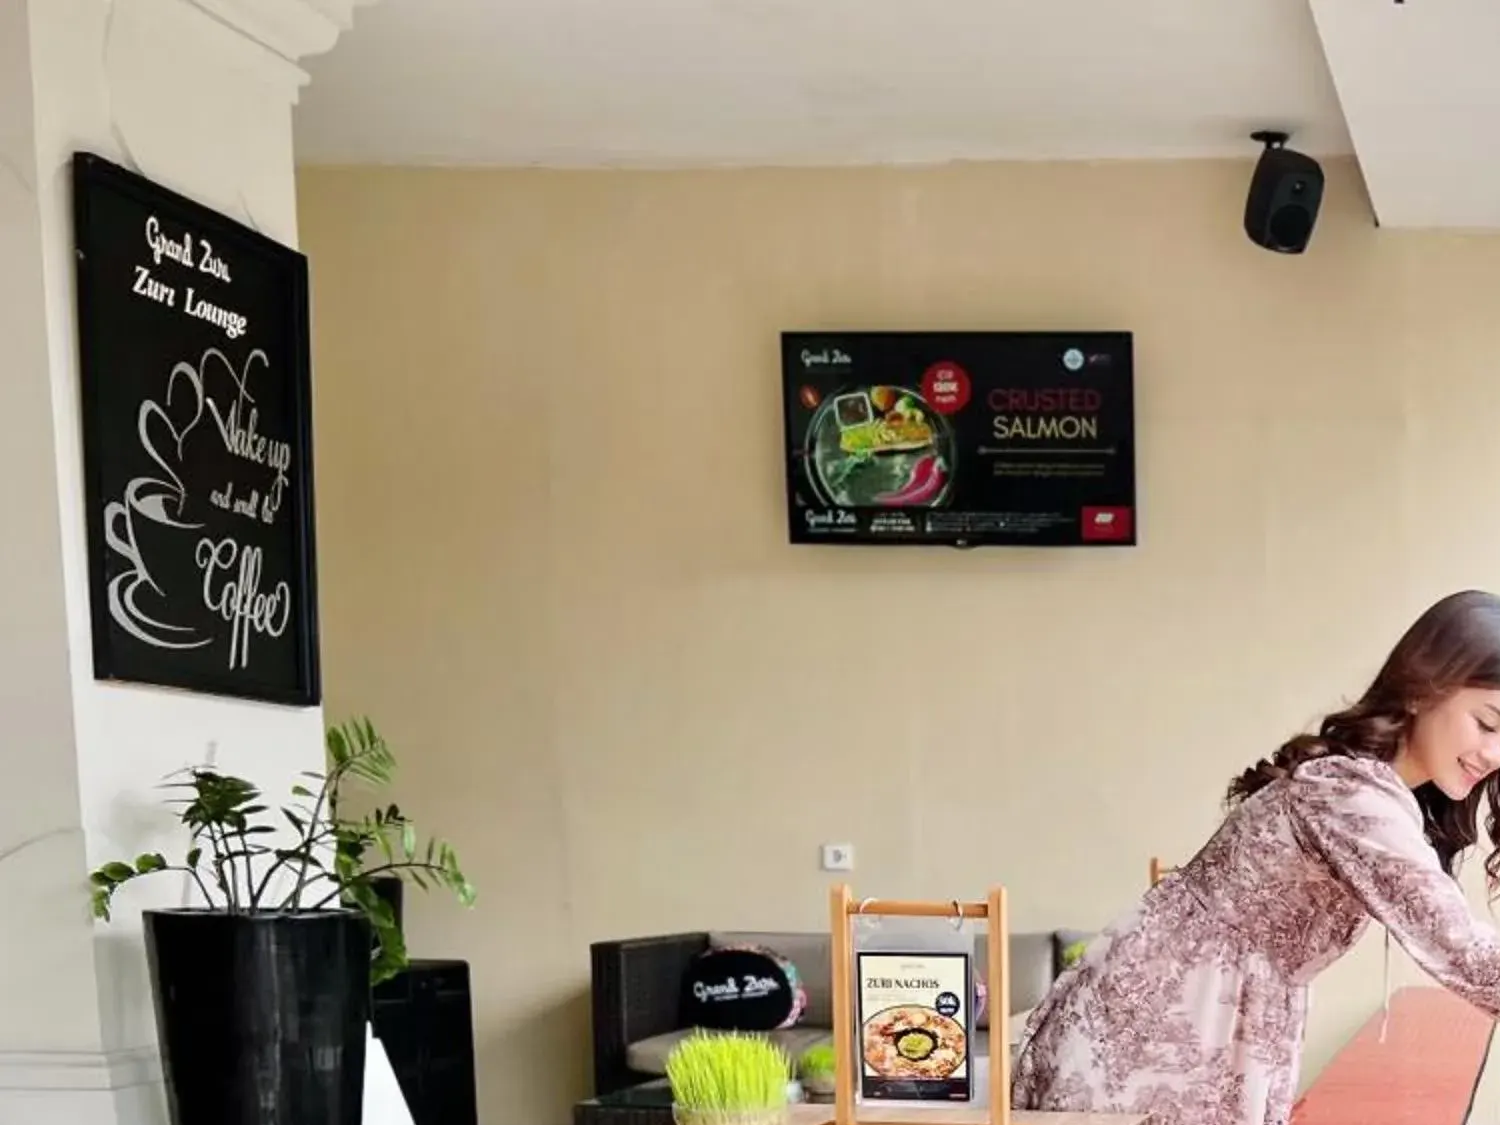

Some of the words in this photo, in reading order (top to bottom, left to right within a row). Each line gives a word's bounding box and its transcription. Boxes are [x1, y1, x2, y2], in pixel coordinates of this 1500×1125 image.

[145, 215, 195, 265] Grand
[184, 287, 247, 339] Lounge
[987, 388, 1101, 412] CRUSTED
[992, 415, 1099, 439] SALMON
[267, 438, 291, 511] up
[195, 538, 291, 671] Coffee
[866, 977, 893, 989] ZURI
[895, 977, 940, 989] NACHOS
